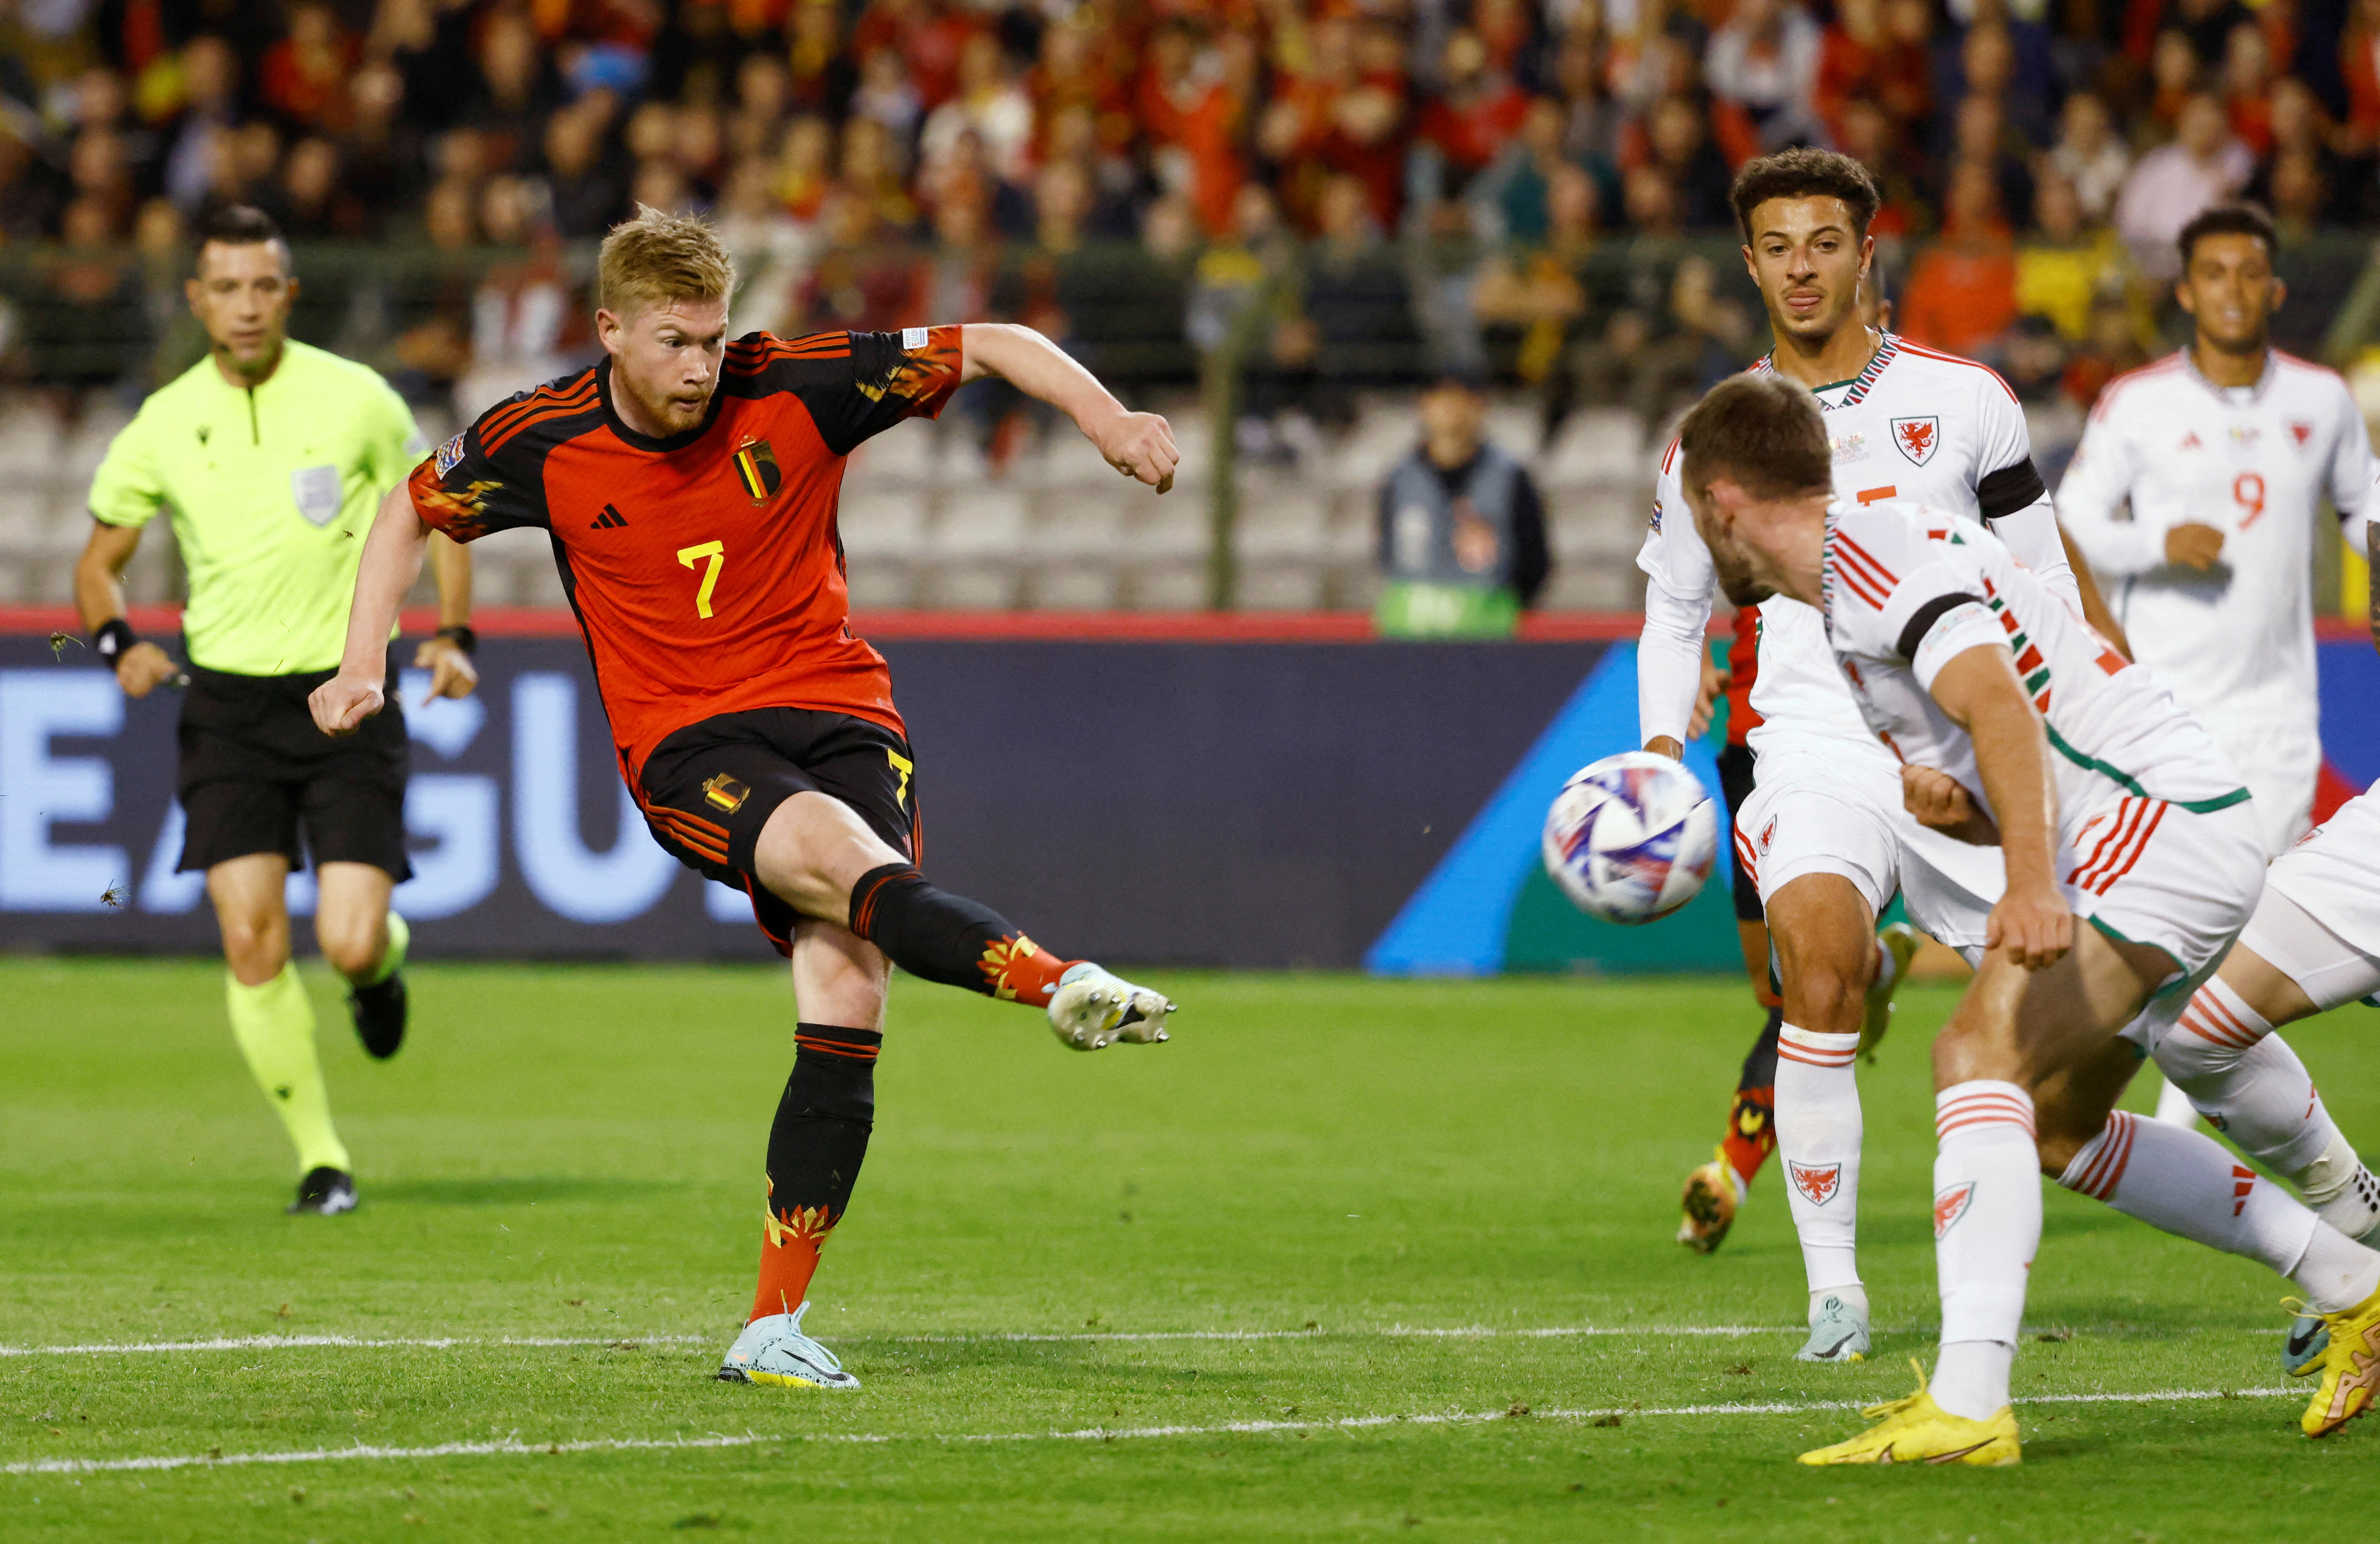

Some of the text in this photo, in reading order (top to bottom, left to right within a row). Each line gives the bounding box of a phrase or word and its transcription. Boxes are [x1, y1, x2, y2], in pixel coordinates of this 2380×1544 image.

[2234, 470, 2265, 531] 9
[677, 540, 724, 619] 7
[888, 748, 913, 818] 7
